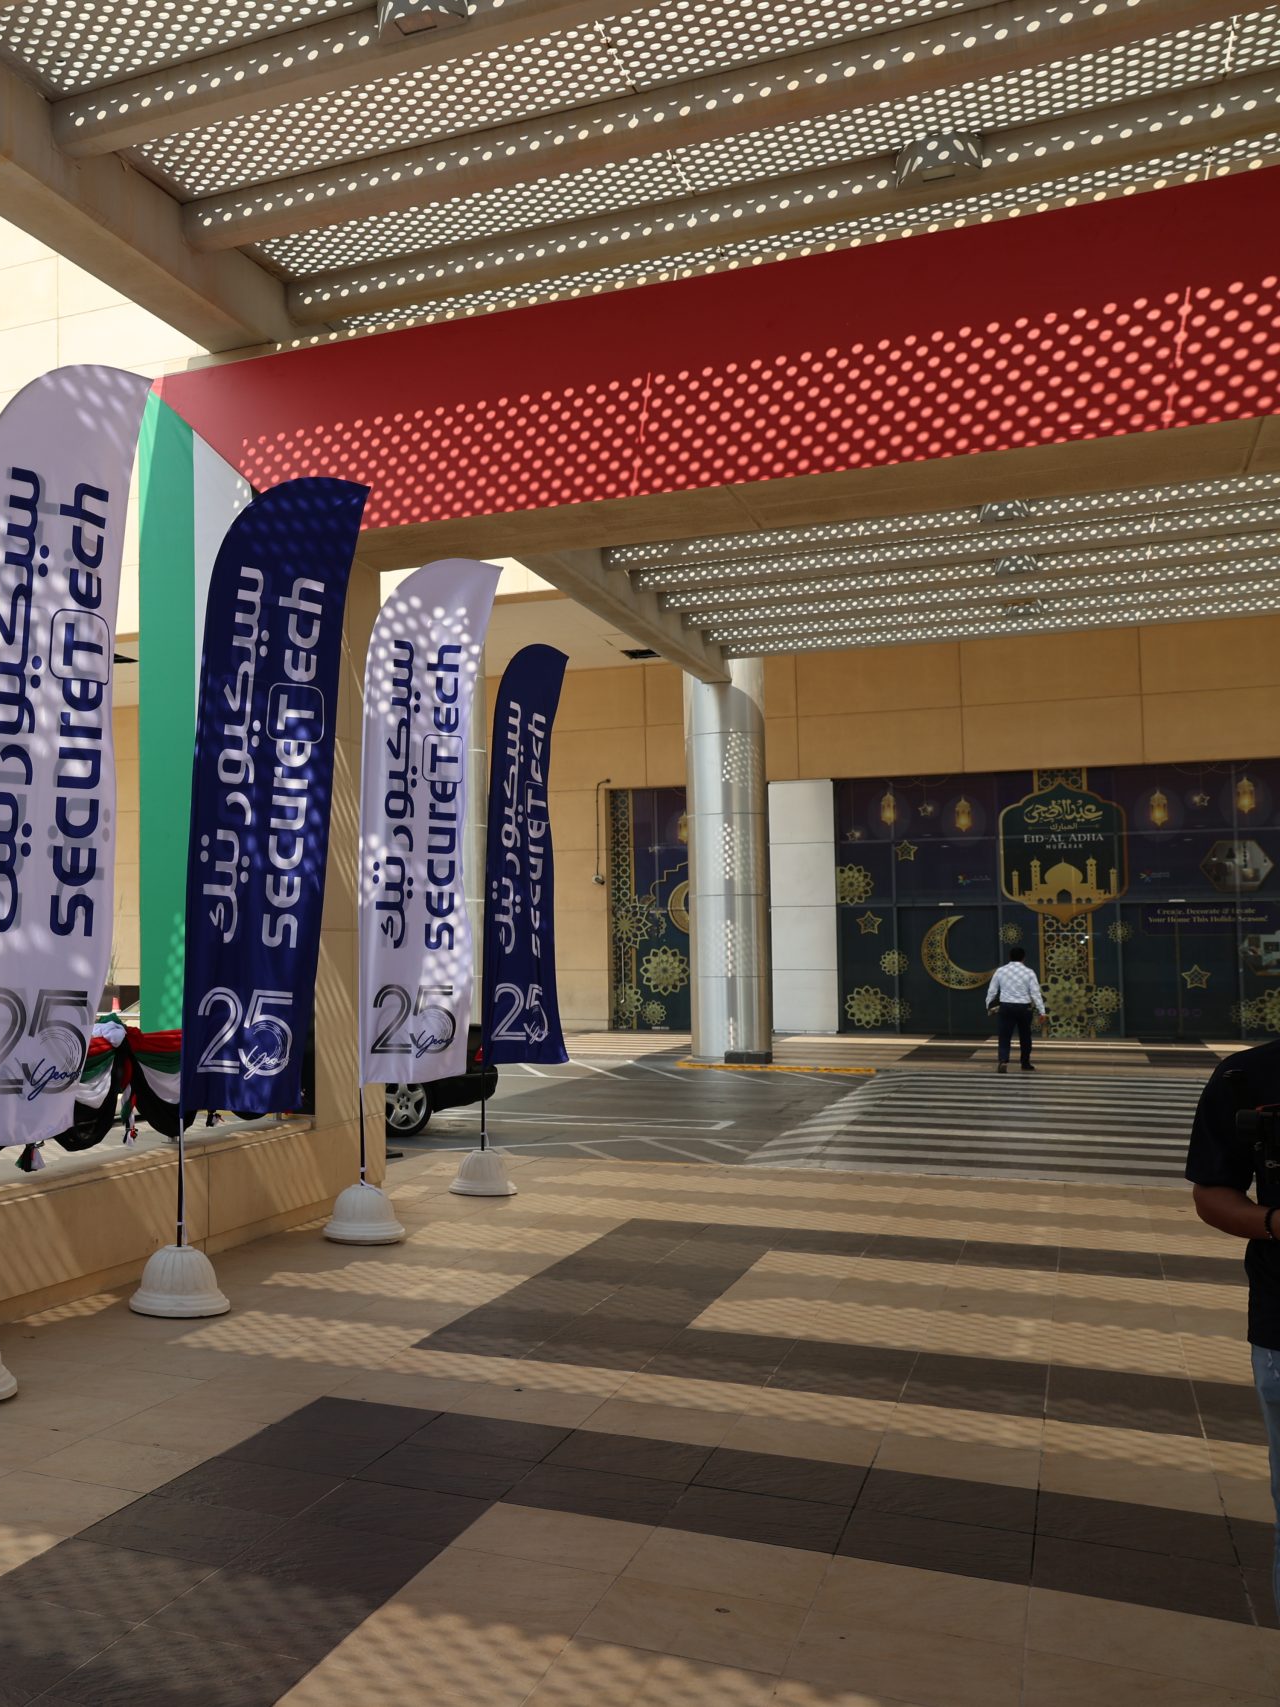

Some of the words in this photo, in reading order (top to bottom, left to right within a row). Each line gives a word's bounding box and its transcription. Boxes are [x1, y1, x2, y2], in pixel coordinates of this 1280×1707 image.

[1068, 833, 1104, 842] ADHA
[197, 986, 293, 1077] 25
[370, 984, 456, 1054] 25
[491, 983, 549, 1042] 25
